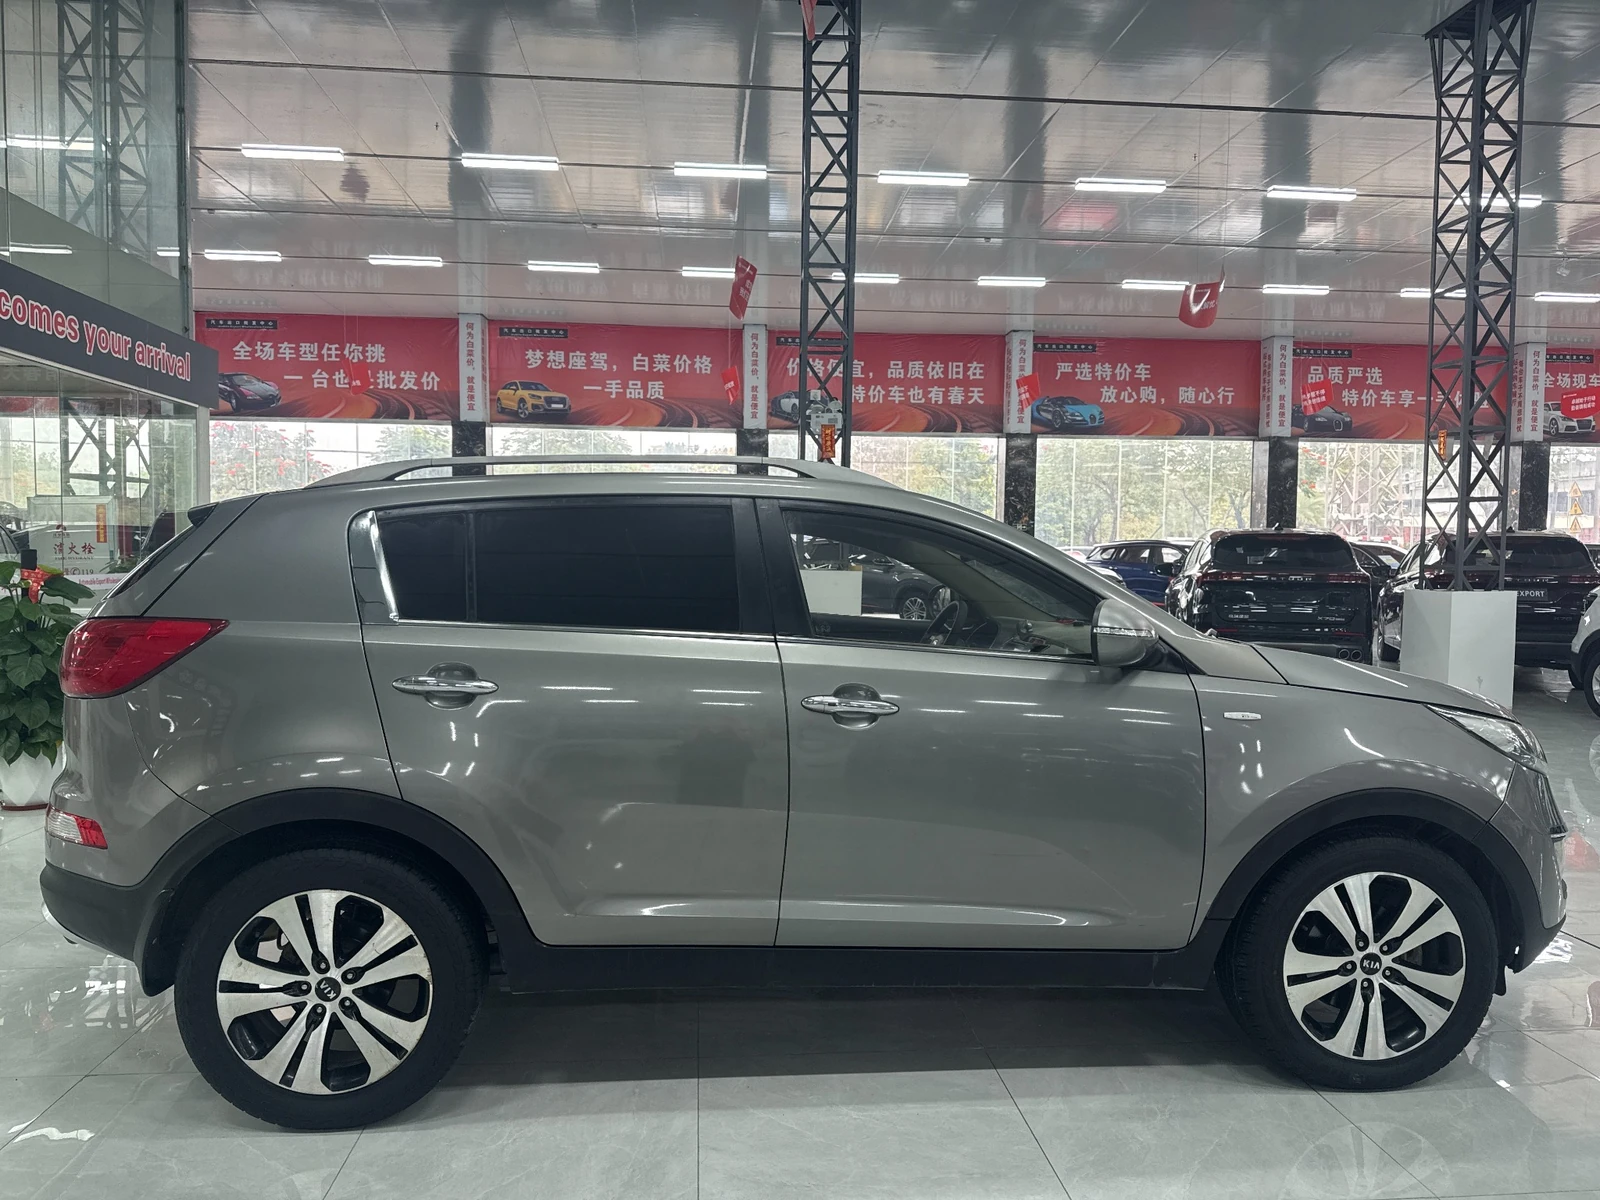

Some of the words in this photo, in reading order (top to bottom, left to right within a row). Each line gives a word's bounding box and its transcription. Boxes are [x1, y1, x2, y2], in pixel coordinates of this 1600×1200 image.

[0, 289, 80, 343] comes
[83, 320, 131, 361] your
[135, 342, 191, 382] arrival
[232, 341, 386, 363] 全场车型任你挑
[525, 349, 712, 375] 梦想座驾，白菜价格
[283, 369, 440, 391] 一台也批发价
[1055, 362, 1151, 381] 严选特价车
[1307, 366, 1382, 385] 品质严选
[583, 380, 665, 400] 一手品质
[851, 385, 985, 405] 特价车也有春天
[1100, 386, 1235, 405] 放心购，随心行
[53, 541, 96, 555] 消火栓
[1362, 958, 1380, 970] KIA
[318, 979, 337, 1000] KIA
